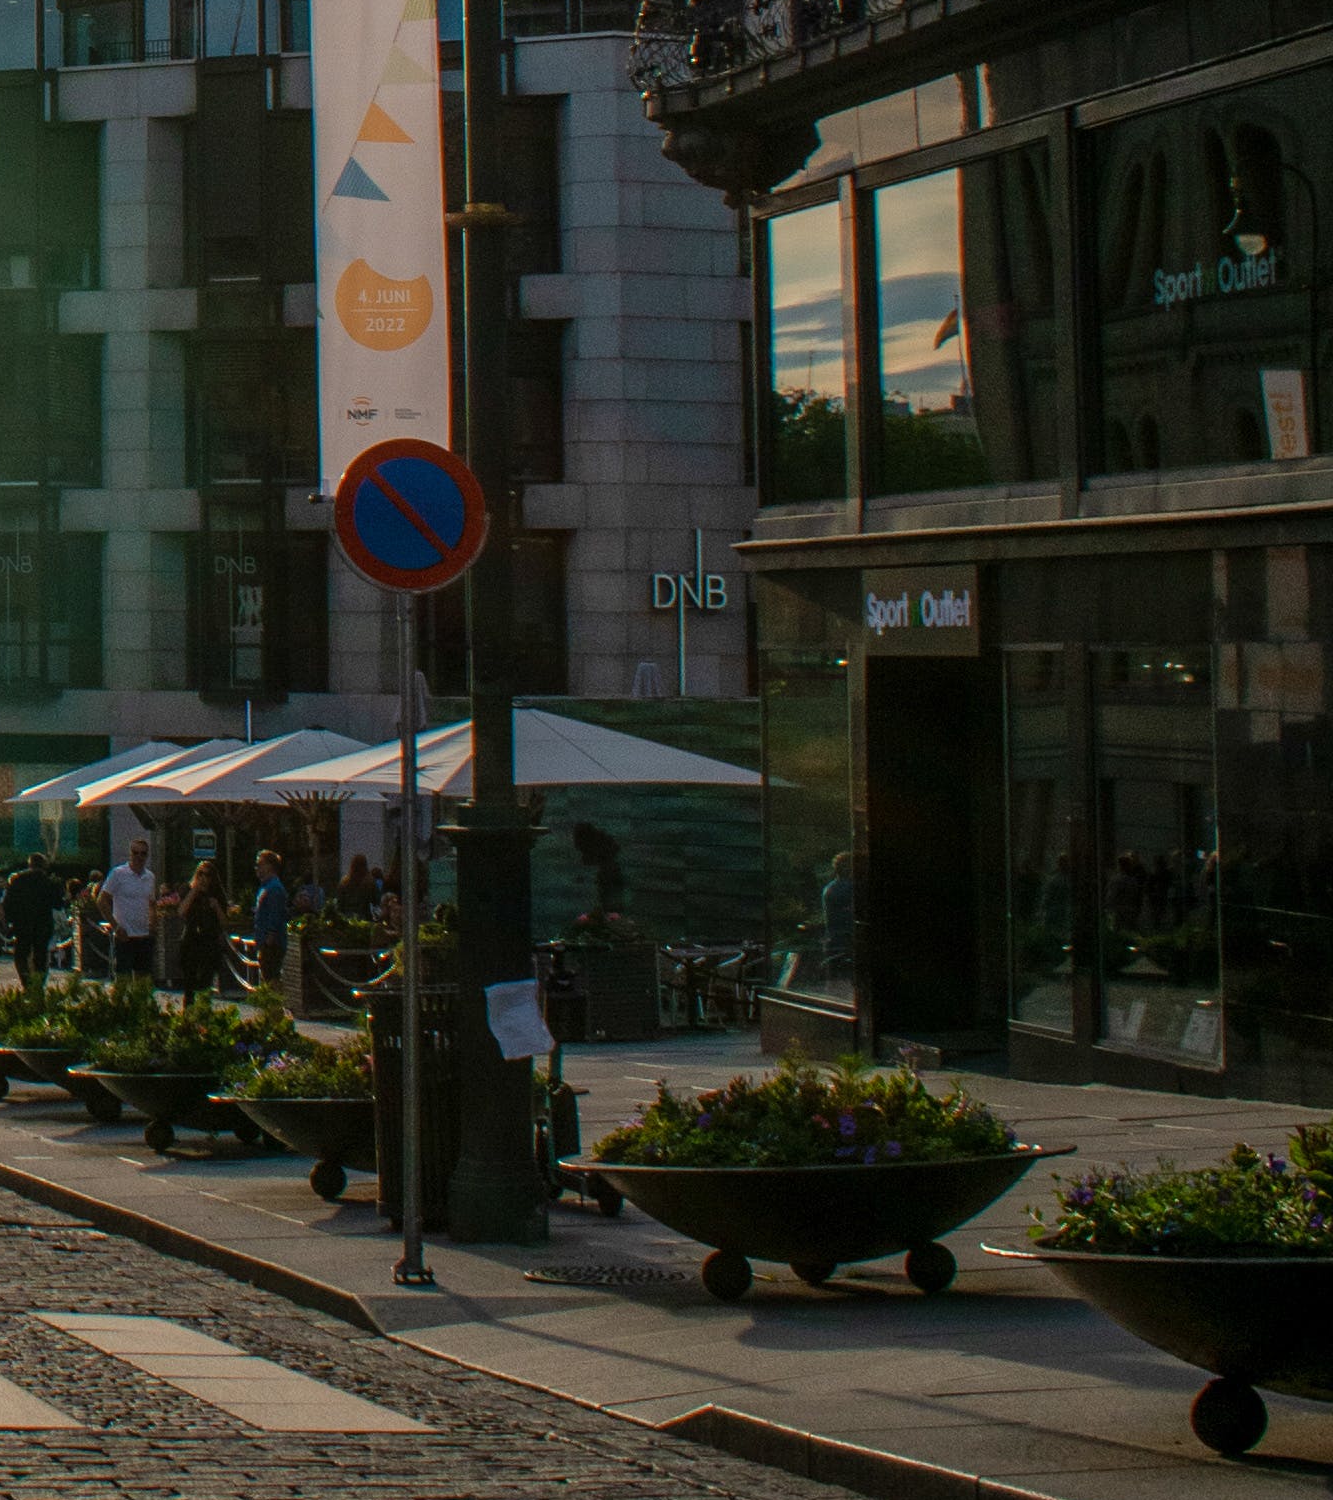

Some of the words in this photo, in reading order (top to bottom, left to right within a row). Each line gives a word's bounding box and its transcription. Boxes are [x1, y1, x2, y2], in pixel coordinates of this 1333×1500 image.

[1154, 262, 1203, 311] Sport
[1217, 248, 1277, 294] Outlet
[375, 290, 411, 304] JUNI
[365, 318, 406, 333] 2022
[347, 408, 378, 420] NMF
[866, 591, 908, 635] Sport
[919, 588, 970, 628] Outlet
